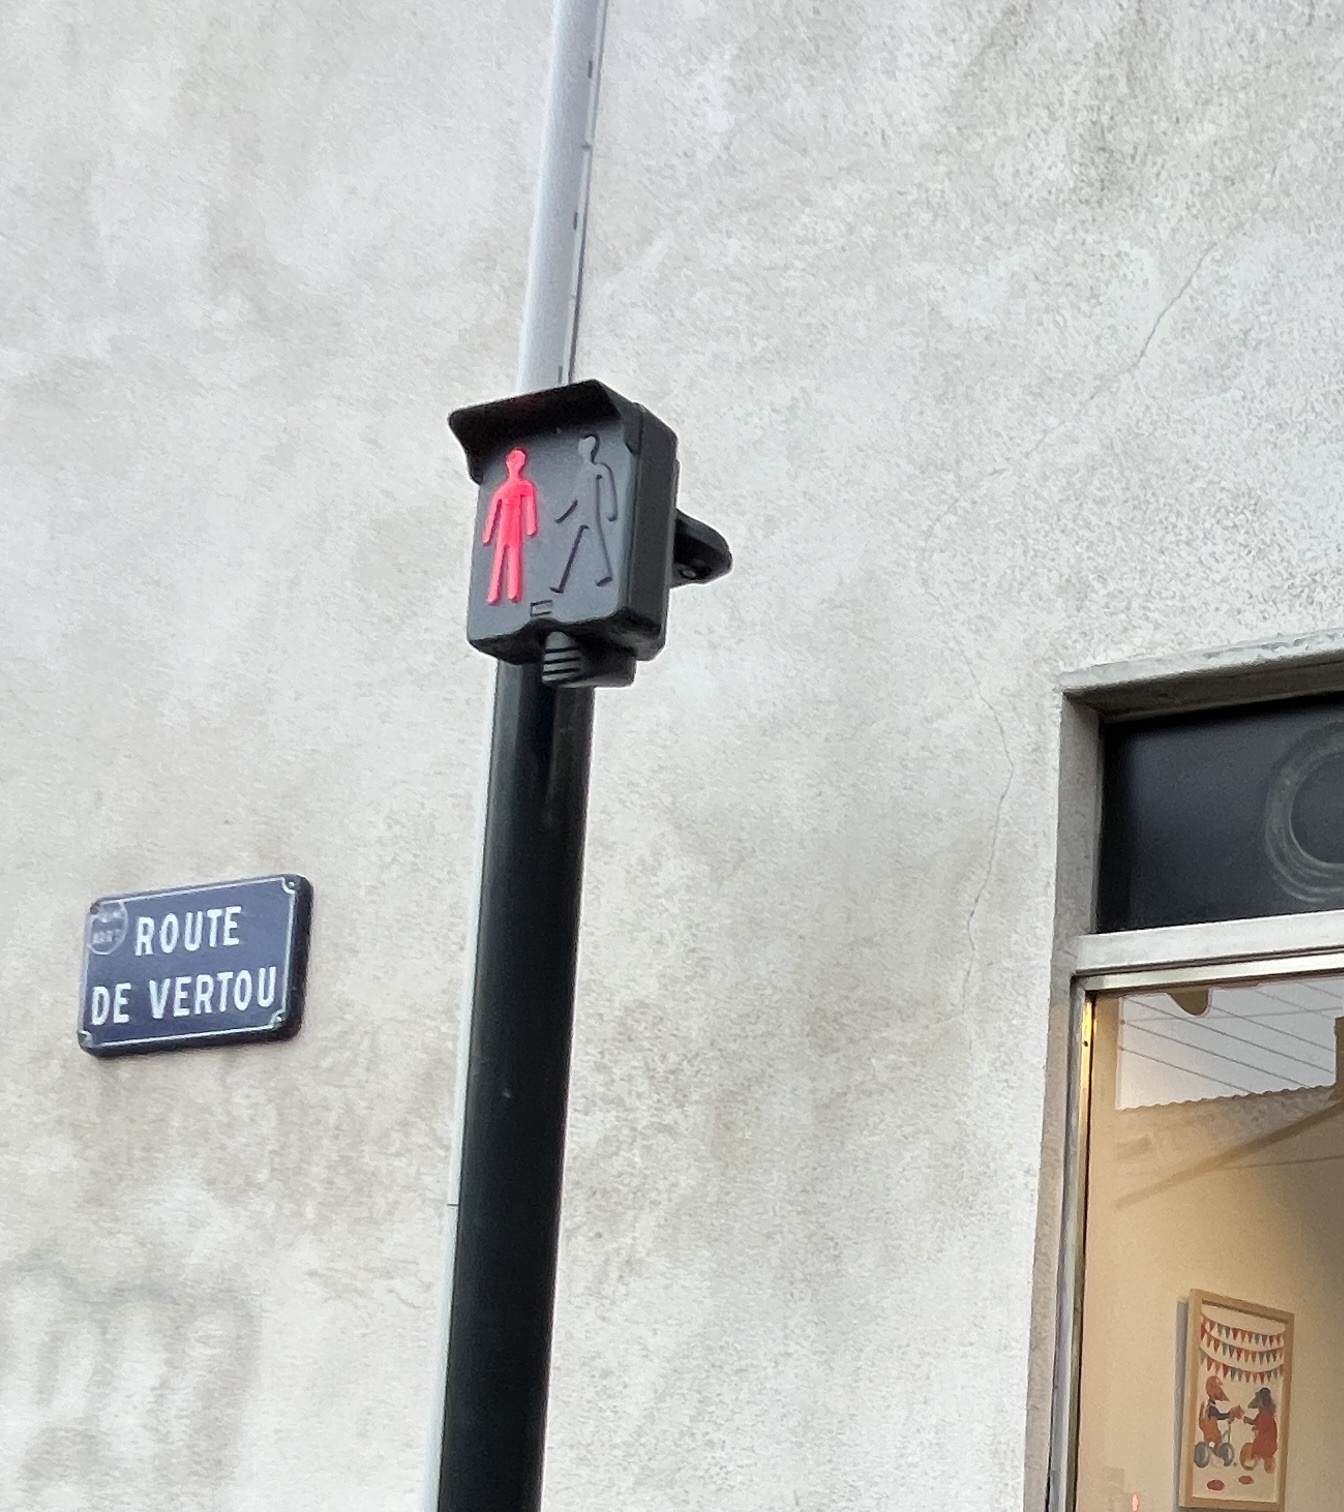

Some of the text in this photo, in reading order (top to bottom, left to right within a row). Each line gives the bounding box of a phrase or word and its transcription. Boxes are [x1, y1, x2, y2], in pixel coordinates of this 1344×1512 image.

[134, 905, 242, 956] ROUTE
[90, 966, 278, 1026] DE VERTOU
